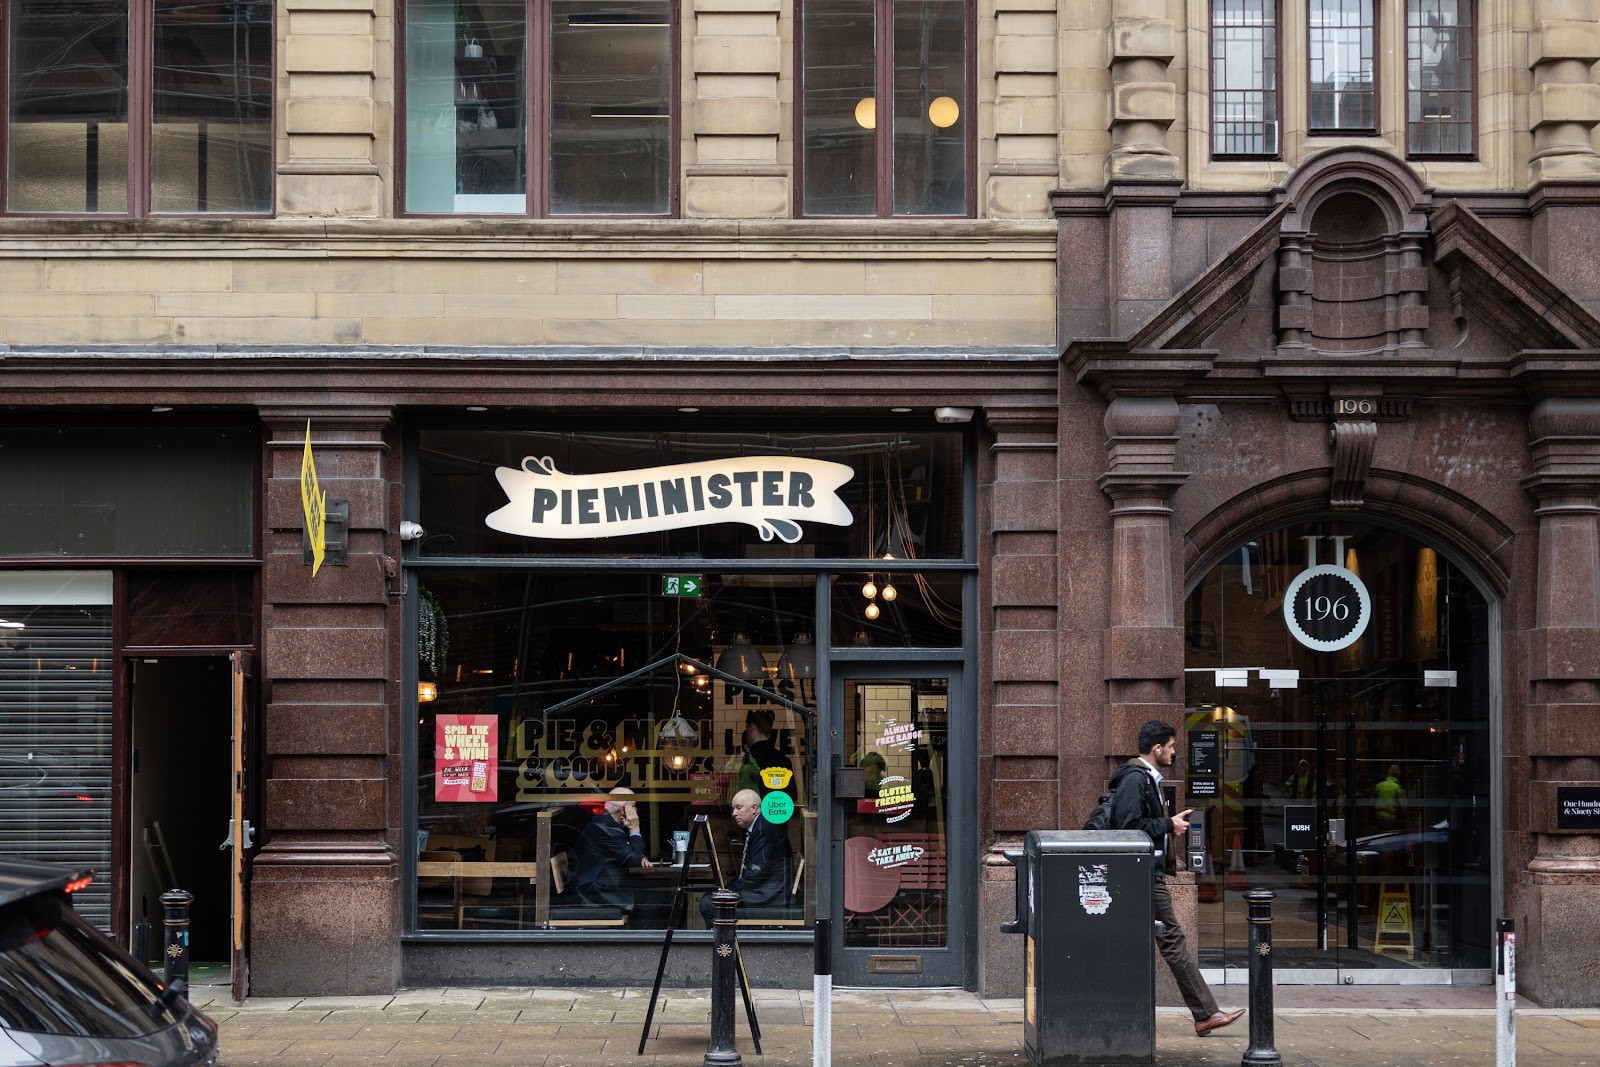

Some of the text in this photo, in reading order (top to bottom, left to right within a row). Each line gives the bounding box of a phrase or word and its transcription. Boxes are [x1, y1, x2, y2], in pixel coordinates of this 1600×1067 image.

[1340, 400, 1371, 414] 196
[532, 471, 815, 525] PIEMINISTER
[1305, 595, 1349, 620] 196
[725, 680, 795, 704] PEAS
[444, 725, 488, 735] SPIN THE
[883, 723, 915, 737] ALWAYS
[444, 735, 488, 747] WHEEL
[517, 719, 575, 758] PIE
[579, 719, 612, 757] &
[875, 735, 895, 746] FREE
[896, 730, 923, 743] RANGE
[444, 747, 488, 760] & WIN!
[516, 756, 544, 787] &
[546, 756, 624, 787] GOOD
[631, 756, 717, 787] TIMES
[879, 785, 912, 798] GLUTEN
[1571, 808, 1592, 817] Ninety
[877, 844, 913, 857] EAT IN OR
[875, 851, 915, 865] TAKE AWAY
